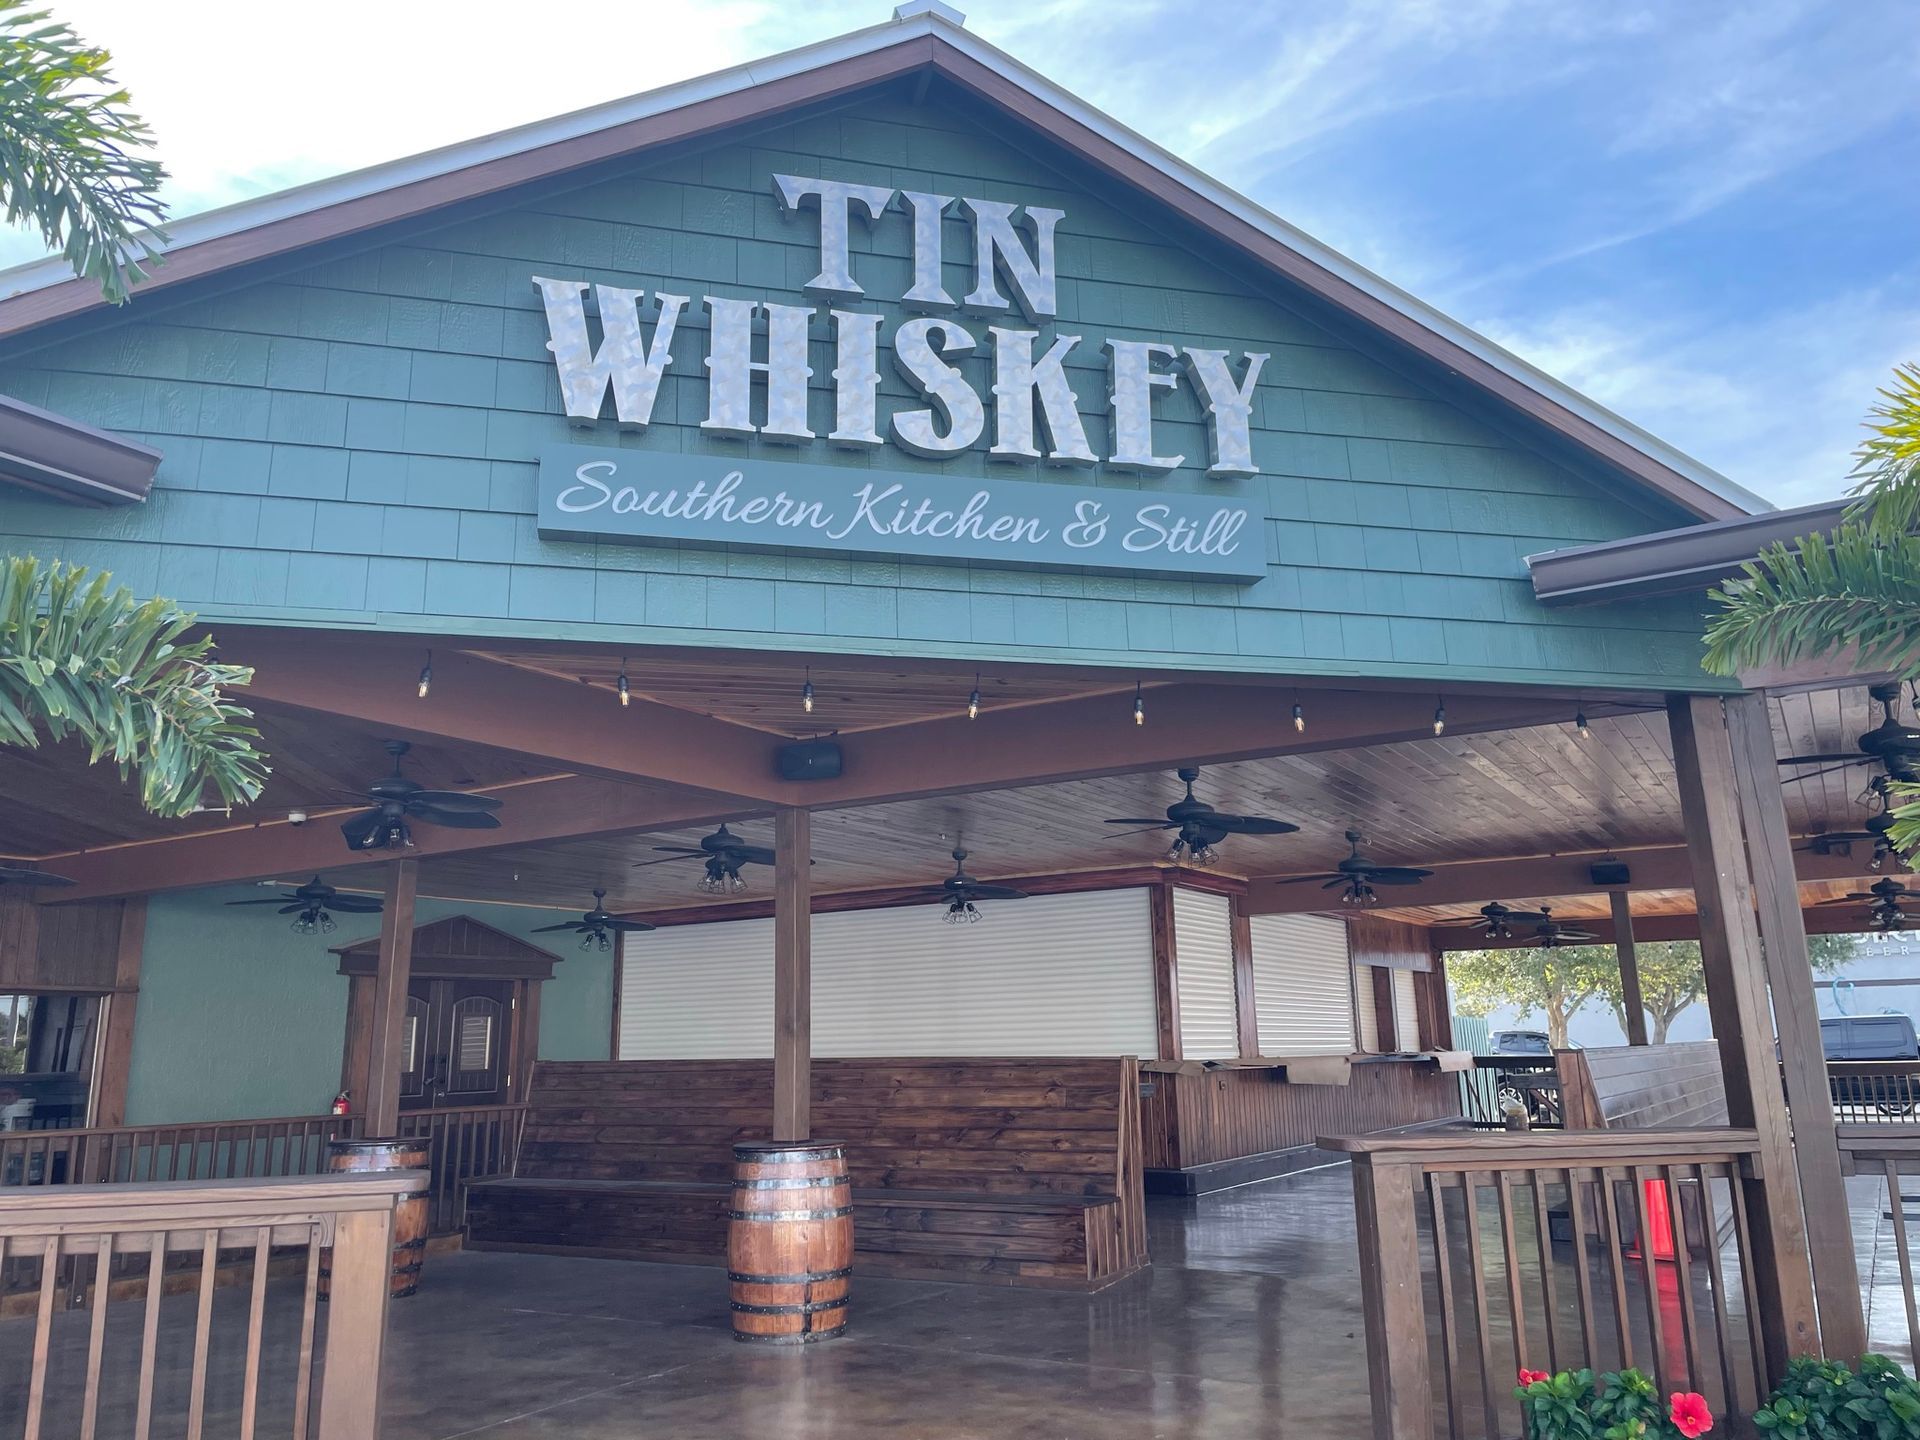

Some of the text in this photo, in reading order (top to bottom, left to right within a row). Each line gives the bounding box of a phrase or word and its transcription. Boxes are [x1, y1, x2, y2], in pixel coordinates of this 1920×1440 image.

[772, 173, 1066, 323] TIN
[532, 275, 1271, 479] WHISKEY
[556, 460, 1248, 557] Southern Kitchen & Still
